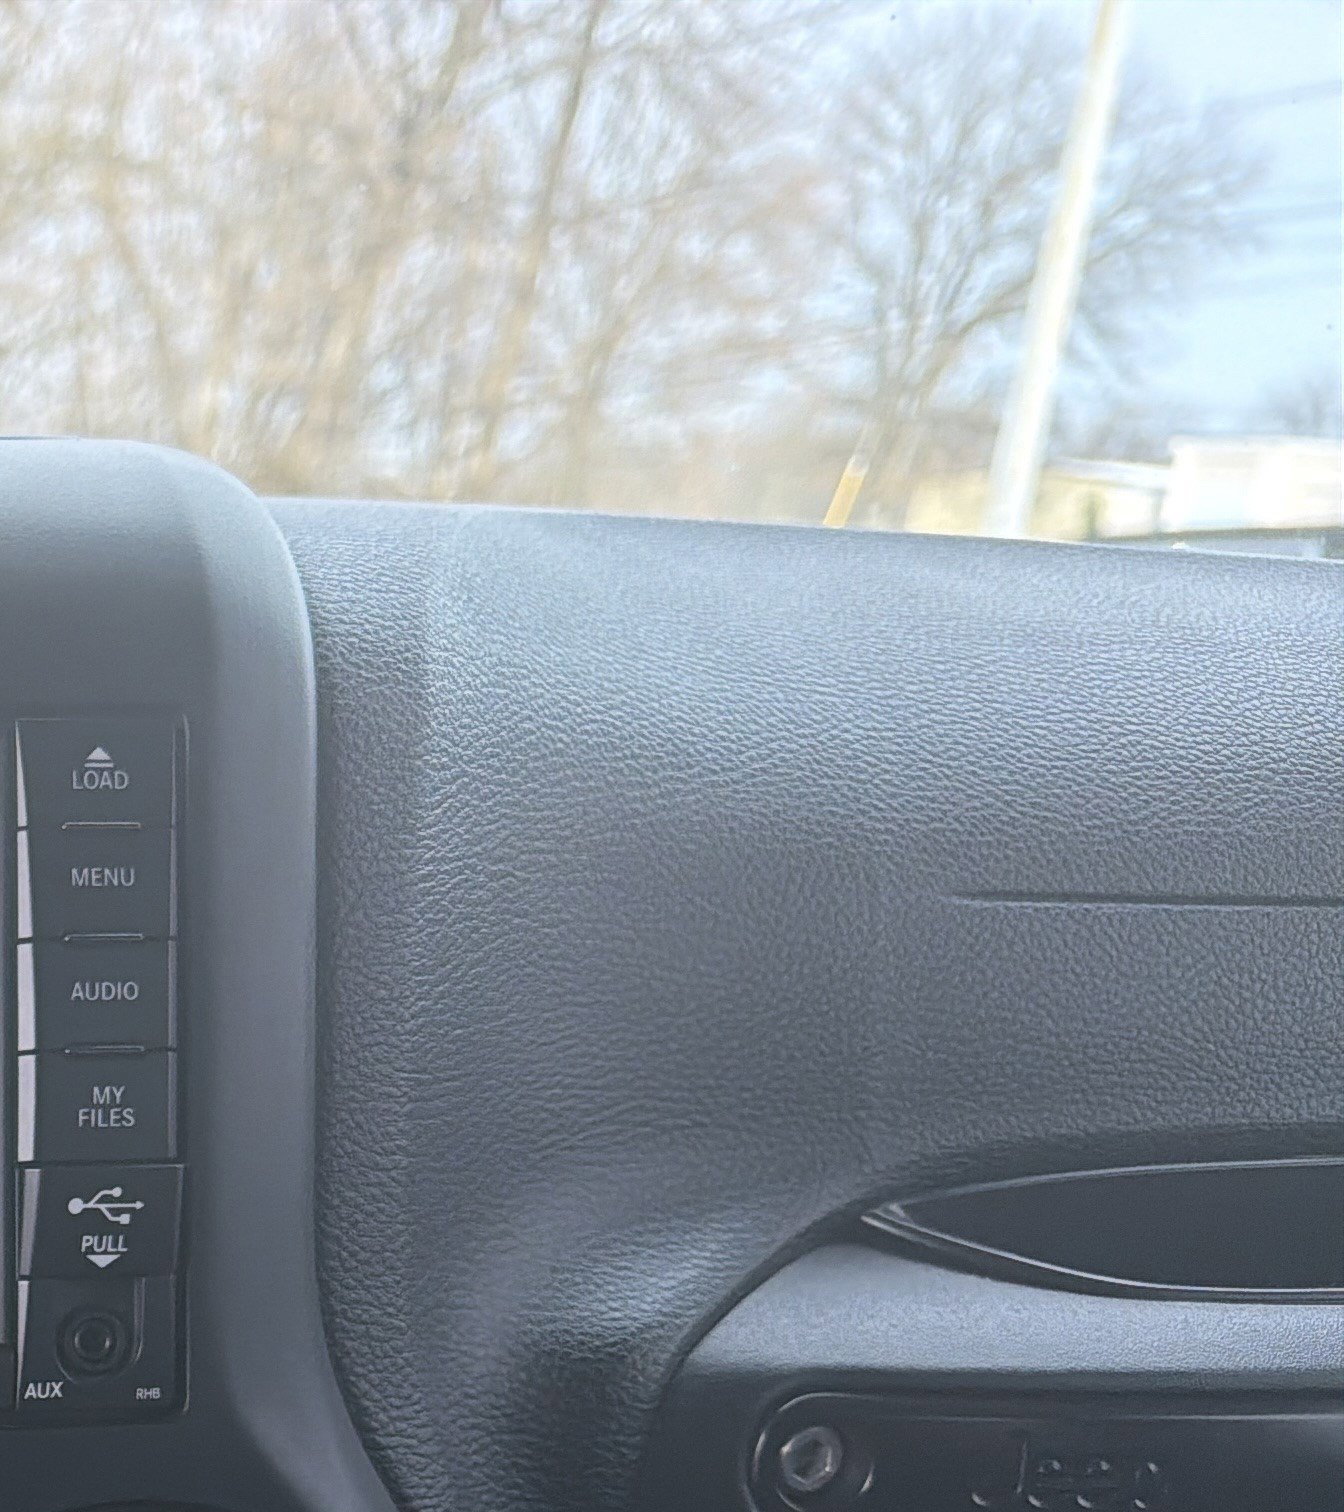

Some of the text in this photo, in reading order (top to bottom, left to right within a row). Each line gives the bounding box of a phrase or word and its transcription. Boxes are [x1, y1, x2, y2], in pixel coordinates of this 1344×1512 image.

[72, 769, 129, 790] LOAD
[71, 867, 135, 887] MENU
[70, 981, 139, 1001] AUDIO
[92, 1085, 125, 1106] MY
[78, 1107, 136, 1128] FILES
[81, 1235, 129, 1254] PULL
[23, 1381, 64, 1400] AUX
[135, 1387, 161, 1400] RHB
